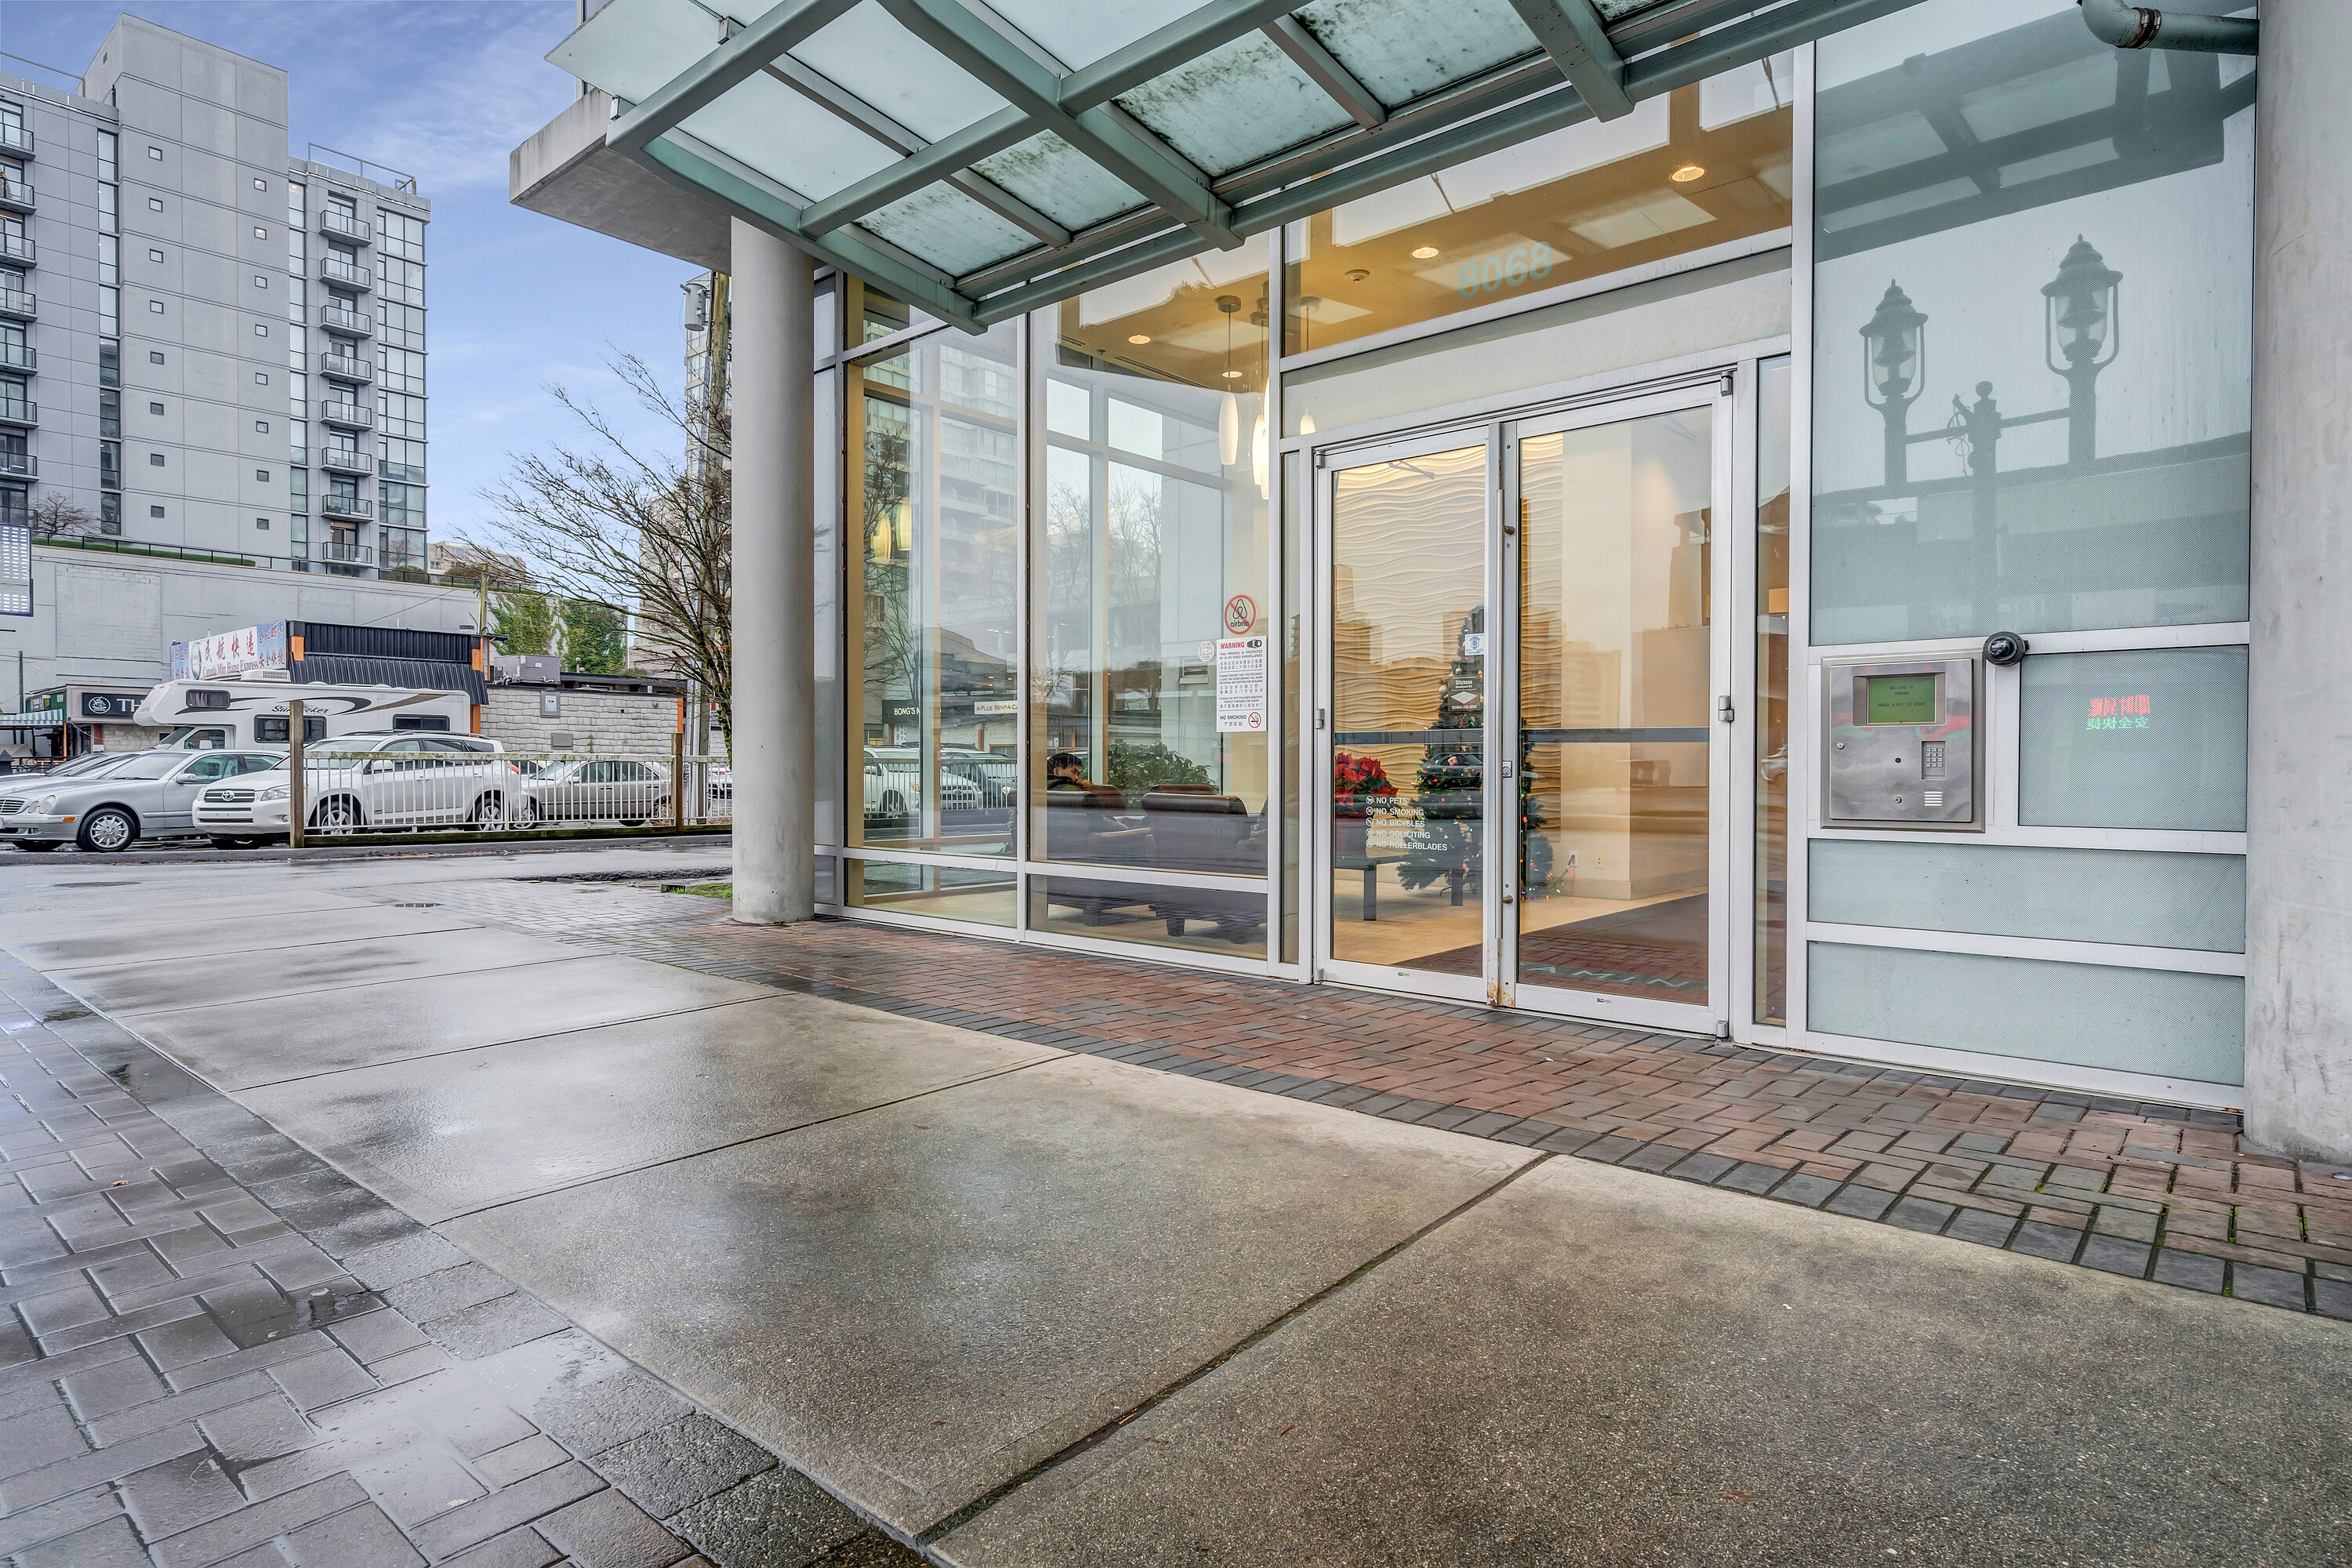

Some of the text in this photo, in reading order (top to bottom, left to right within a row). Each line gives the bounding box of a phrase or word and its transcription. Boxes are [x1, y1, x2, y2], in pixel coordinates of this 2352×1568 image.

[1459, 241, 1552, 299] 8068
[240, 659, 259, 672] Express
[894, 707, 916, 716] BONG'S
[1389, 808, 1425, 816] SMOKING
[1389, 830, 1431, 839] SOLICITING
[1389, 841, 1448, 851] ROLLERBLADES
[1519, 962, 1708, 990] AMIN
